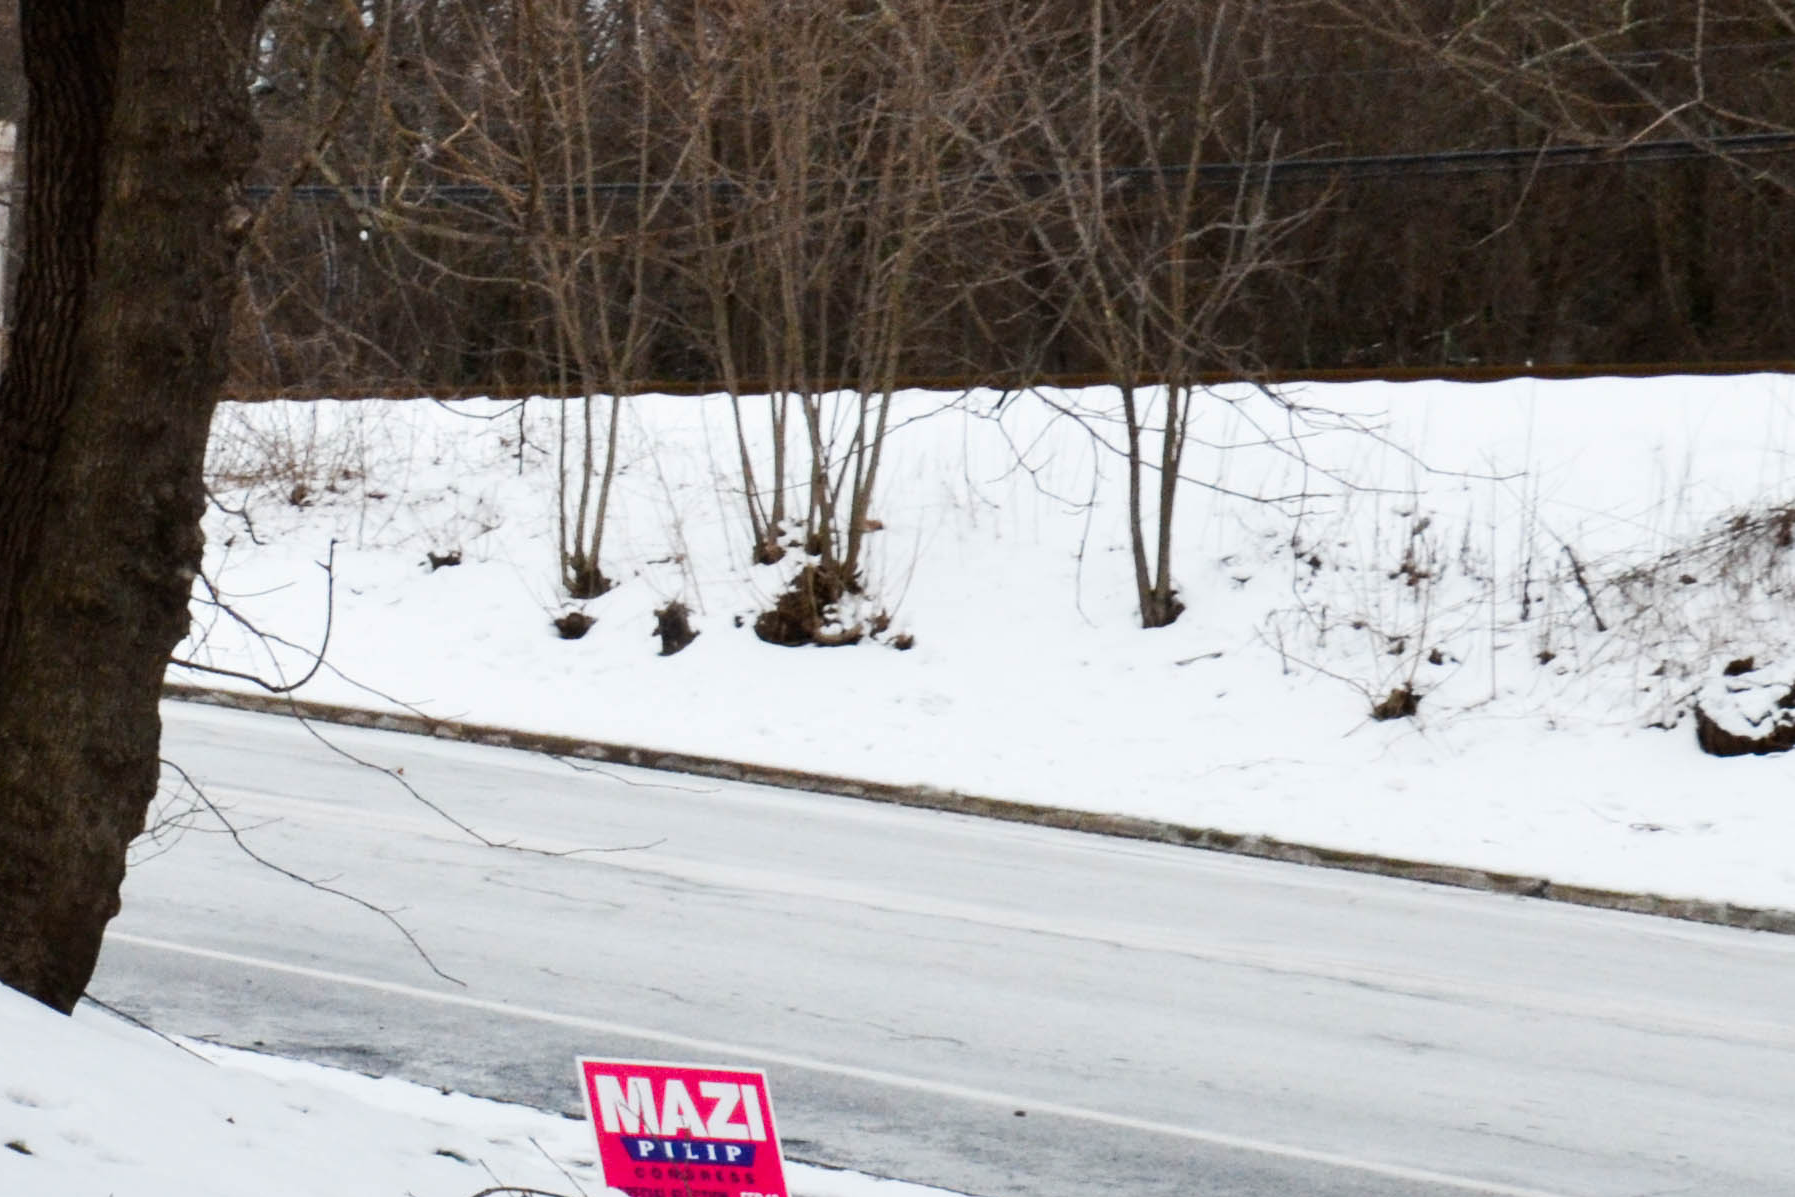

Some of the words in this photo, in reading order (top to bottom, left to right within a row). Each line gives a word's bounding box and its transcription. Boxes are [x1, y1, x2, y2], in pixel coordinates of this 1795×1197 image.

[595, 1074, 767, 1141] MAZI
[638, 1140, 742, 1162] PILIP
[634, 1167, 755, 1185] CONGRESS
